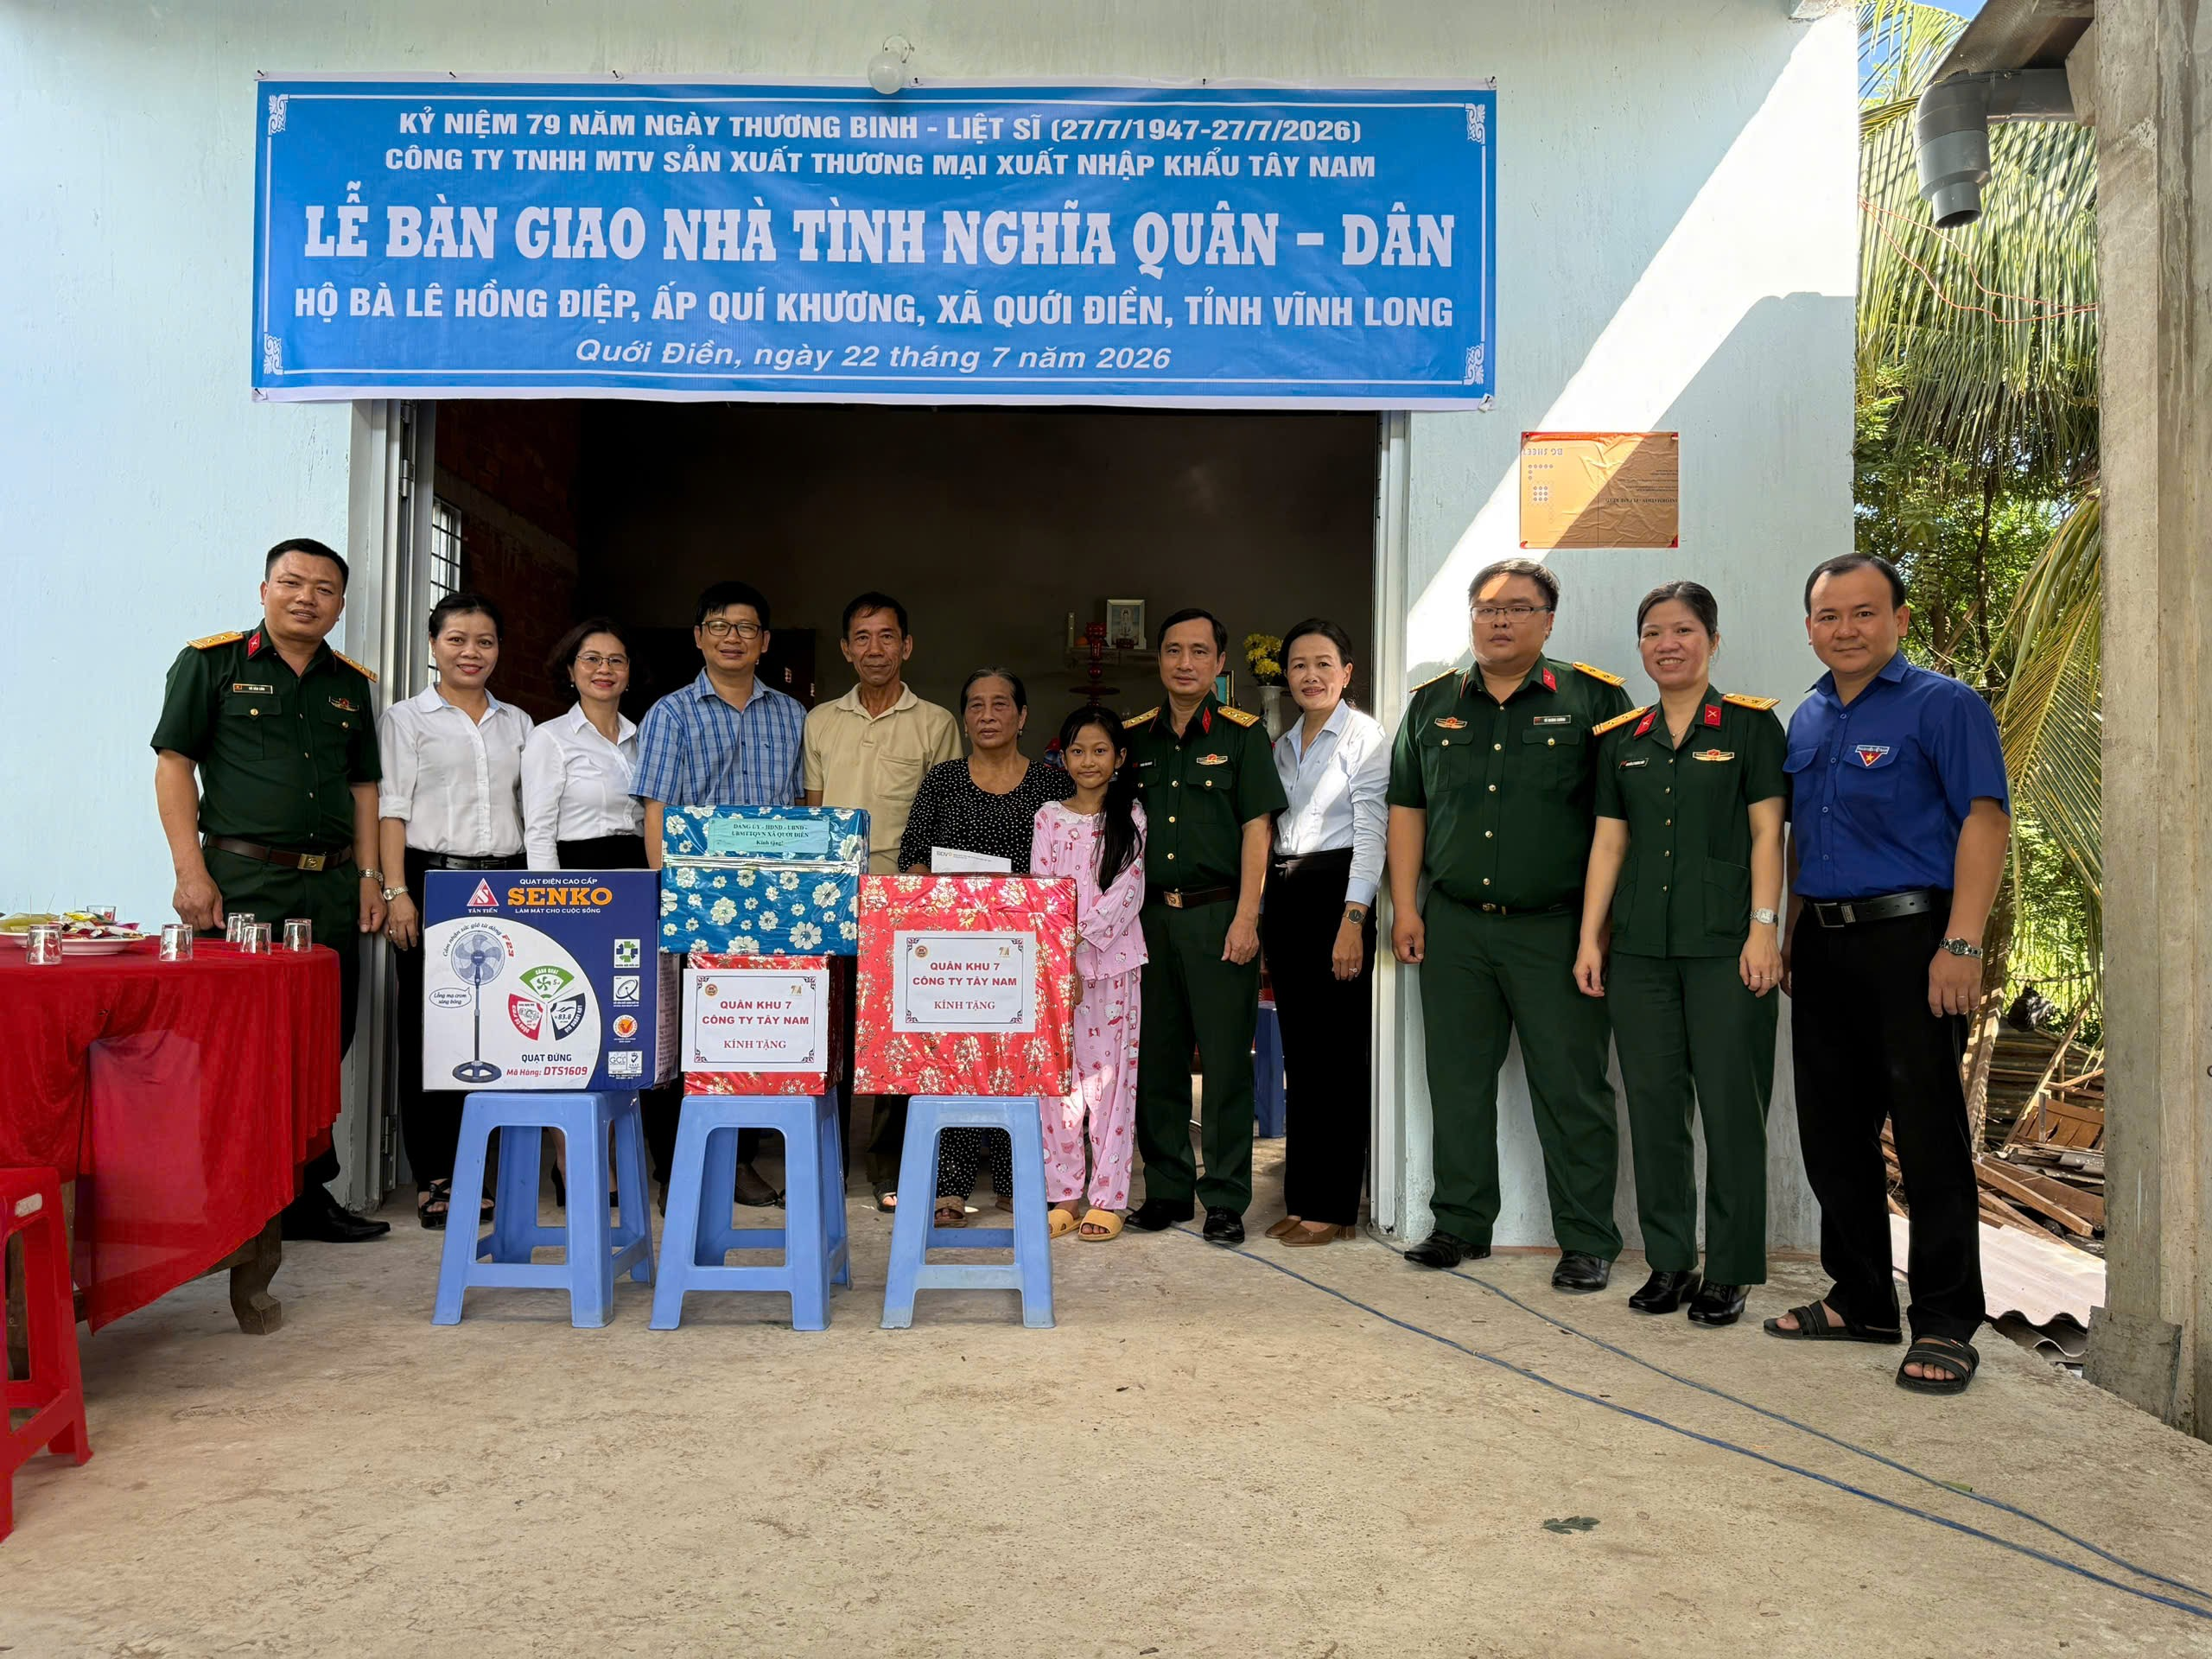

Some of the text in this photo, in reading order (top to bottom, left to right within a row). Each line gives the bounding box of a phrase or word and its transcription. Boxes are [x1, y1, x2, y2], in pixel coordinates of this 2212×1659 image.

[401, 107, 435, 133] KỶ
[445, 110, 517, 138] NIỆM
[527, 115, 560, 135] 79
[570, 111, 634, 135] NĂM
[645, 112, 720, 136] NGÀY
[729, 114, 841, 138] THƯƠNG
[850, 117, 918, 138] BINH
[947, 112, 1004, 144] LIỆT
[1014, 114, 1042, 140] SĨ
[1052, 119, 1360, 143] (27/7/1947-27/7/2026)
[386, 144, 1375, 180] CÔNG TY TNHH MTV SẢN XUẤT THƯƠNG MẠI XUẤT NHẬP KHẨU TÂY NAM
[305, 181, 368, 257] LỄ
[386, 194, 498, 258] BÀN
[516, 207, 645, 259] GIAO
[664, 197, 776, 261] NHÀ
[794, 197, 925, 264] TÌNH
[943, 200, 1116, 264] NGHĨA
[1134, 201, 1279, 280] QUÂN
[1343, 202, 1454, 267] DÂN
[296, 279, 1452, 327] HỘ BÀ LÊ HỒNG ĐIỆP, ẤP QUÍ KHƯƠNG, XÃ QUỚI ĐIỀN, TỈNH VĨNH LONG
[577, 340, 1171, 373] Quới Điền, ngày 22 tháng 7 năm 2026
[507, 887, 613, 906] SENKO
[930, 961, 1001, 971] QUÂN KHU 7
[912, 976, 945, 986] CÔNG
[966, 976, 988, 986] TÂY
[721, 999, 791, 1009] QUÂN KHU 7
[934, 999, 995, 1011] KÍNH TẶNG
[702, 1014, 809, 1025] CÔNG TY TÂY NAM
[724, 1039, 786, 1051] KÍNH TẶNG
[522, 1052, 572, 1064] QUẠT ĐỨNG
[544, 1066, 588, 1075] DTS1609
